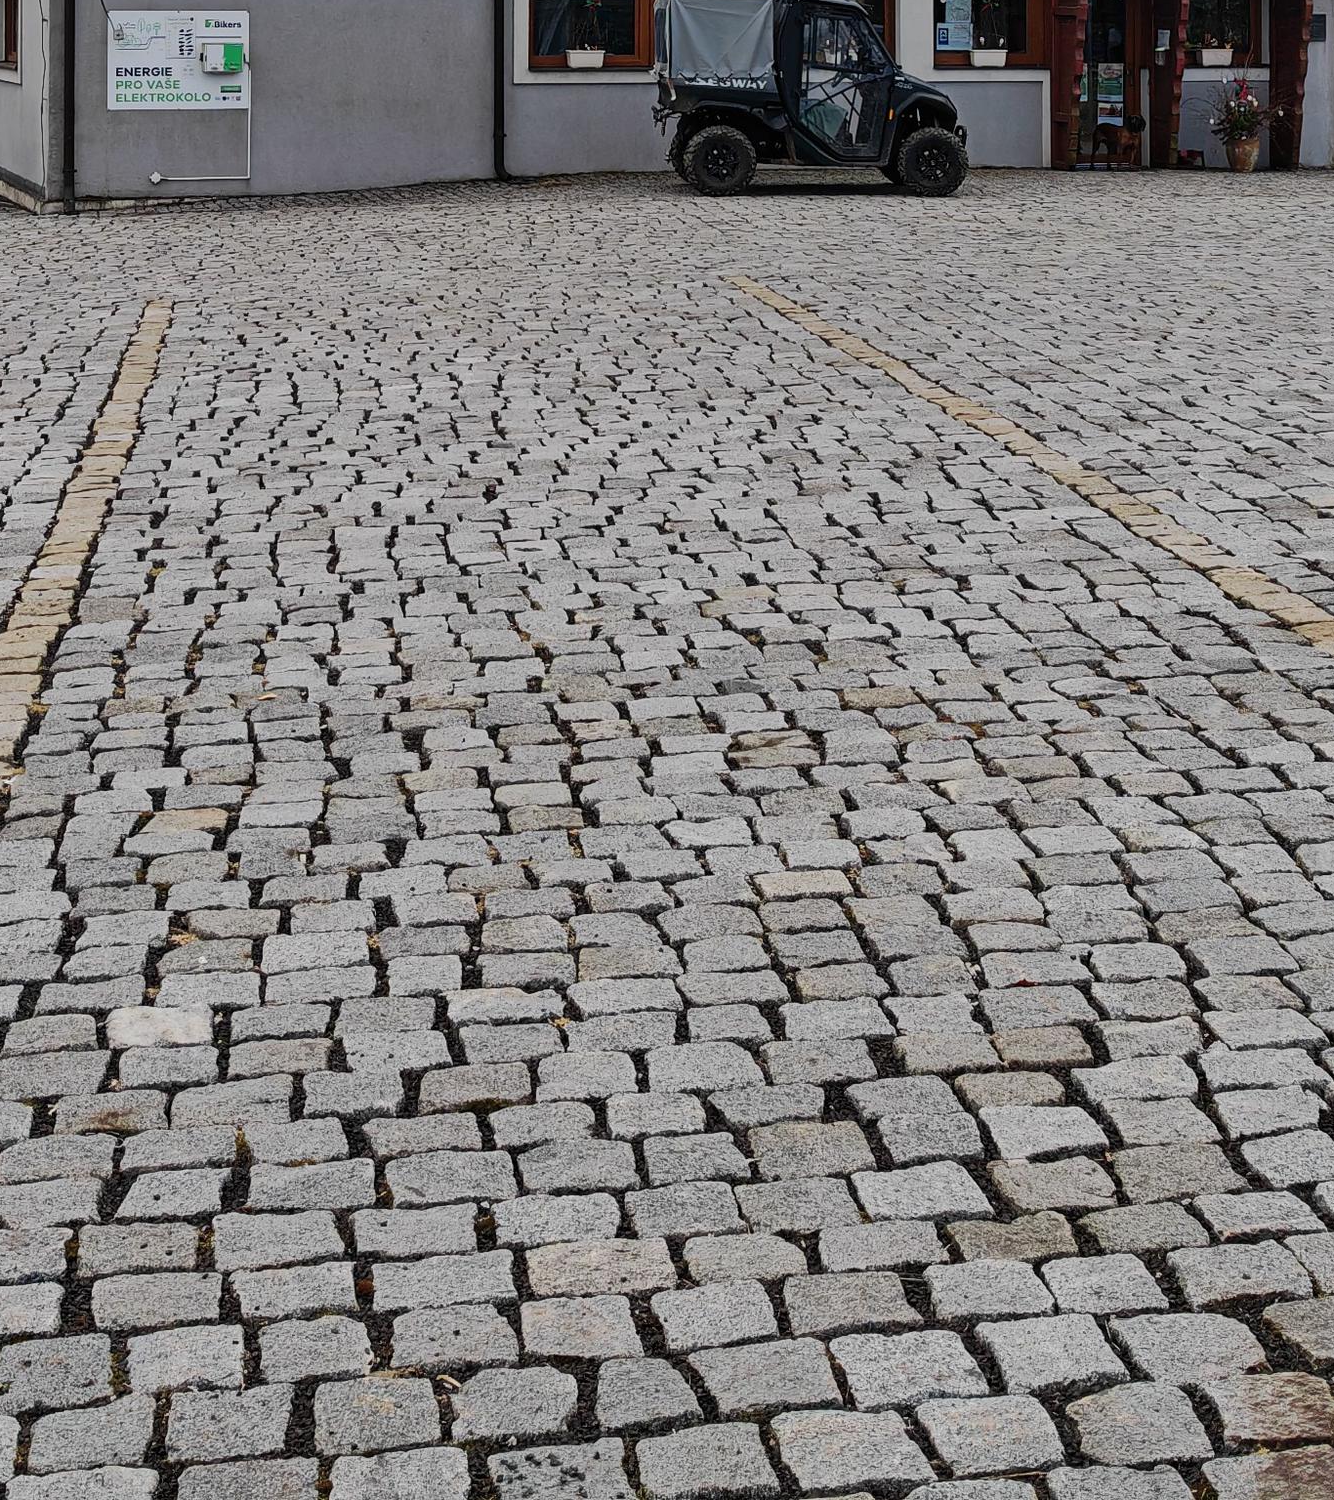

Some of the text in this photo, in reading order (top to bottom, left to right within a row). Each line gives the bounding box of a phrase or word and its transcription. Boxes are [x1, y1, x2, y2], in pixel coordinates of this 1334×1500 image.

[115, 67, 173, 77] ENERGIE
[115, 78, 181, 90] PRO VAŠE
[115, 92, 211, 103] ELEKTROKOLO
